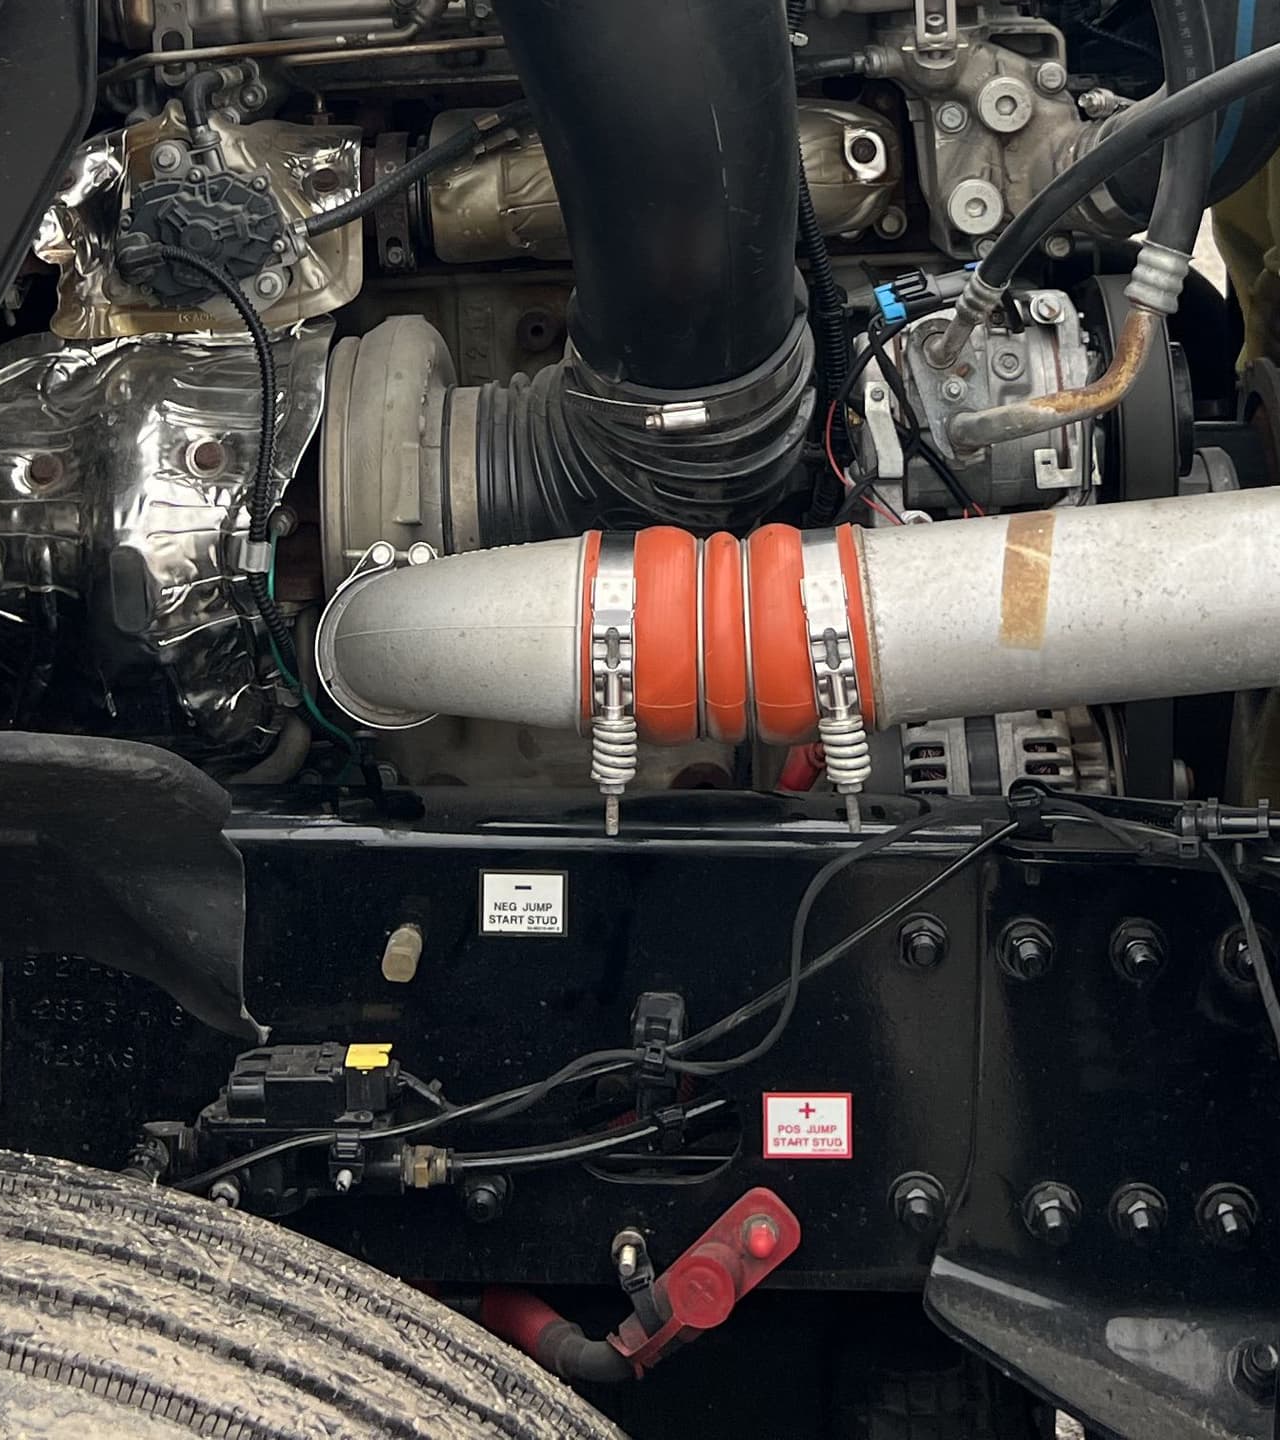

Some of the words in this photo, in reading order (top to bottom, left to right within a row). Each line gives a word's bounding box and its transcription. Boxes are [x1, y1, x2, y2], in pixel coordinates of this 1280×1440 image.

[494, 902, 517, 912] NEG
[522, 902, 553, 912] JUMP
[488, 914, 525, 924] START
[527, 915, 558, 925] STUD
[777, 1124, 801, 1134] POS
[806, 1124, 837, 1134] JUMP
[773, 1137, 810, 1147] START
[812, 1137, 843, 1147] STUD
